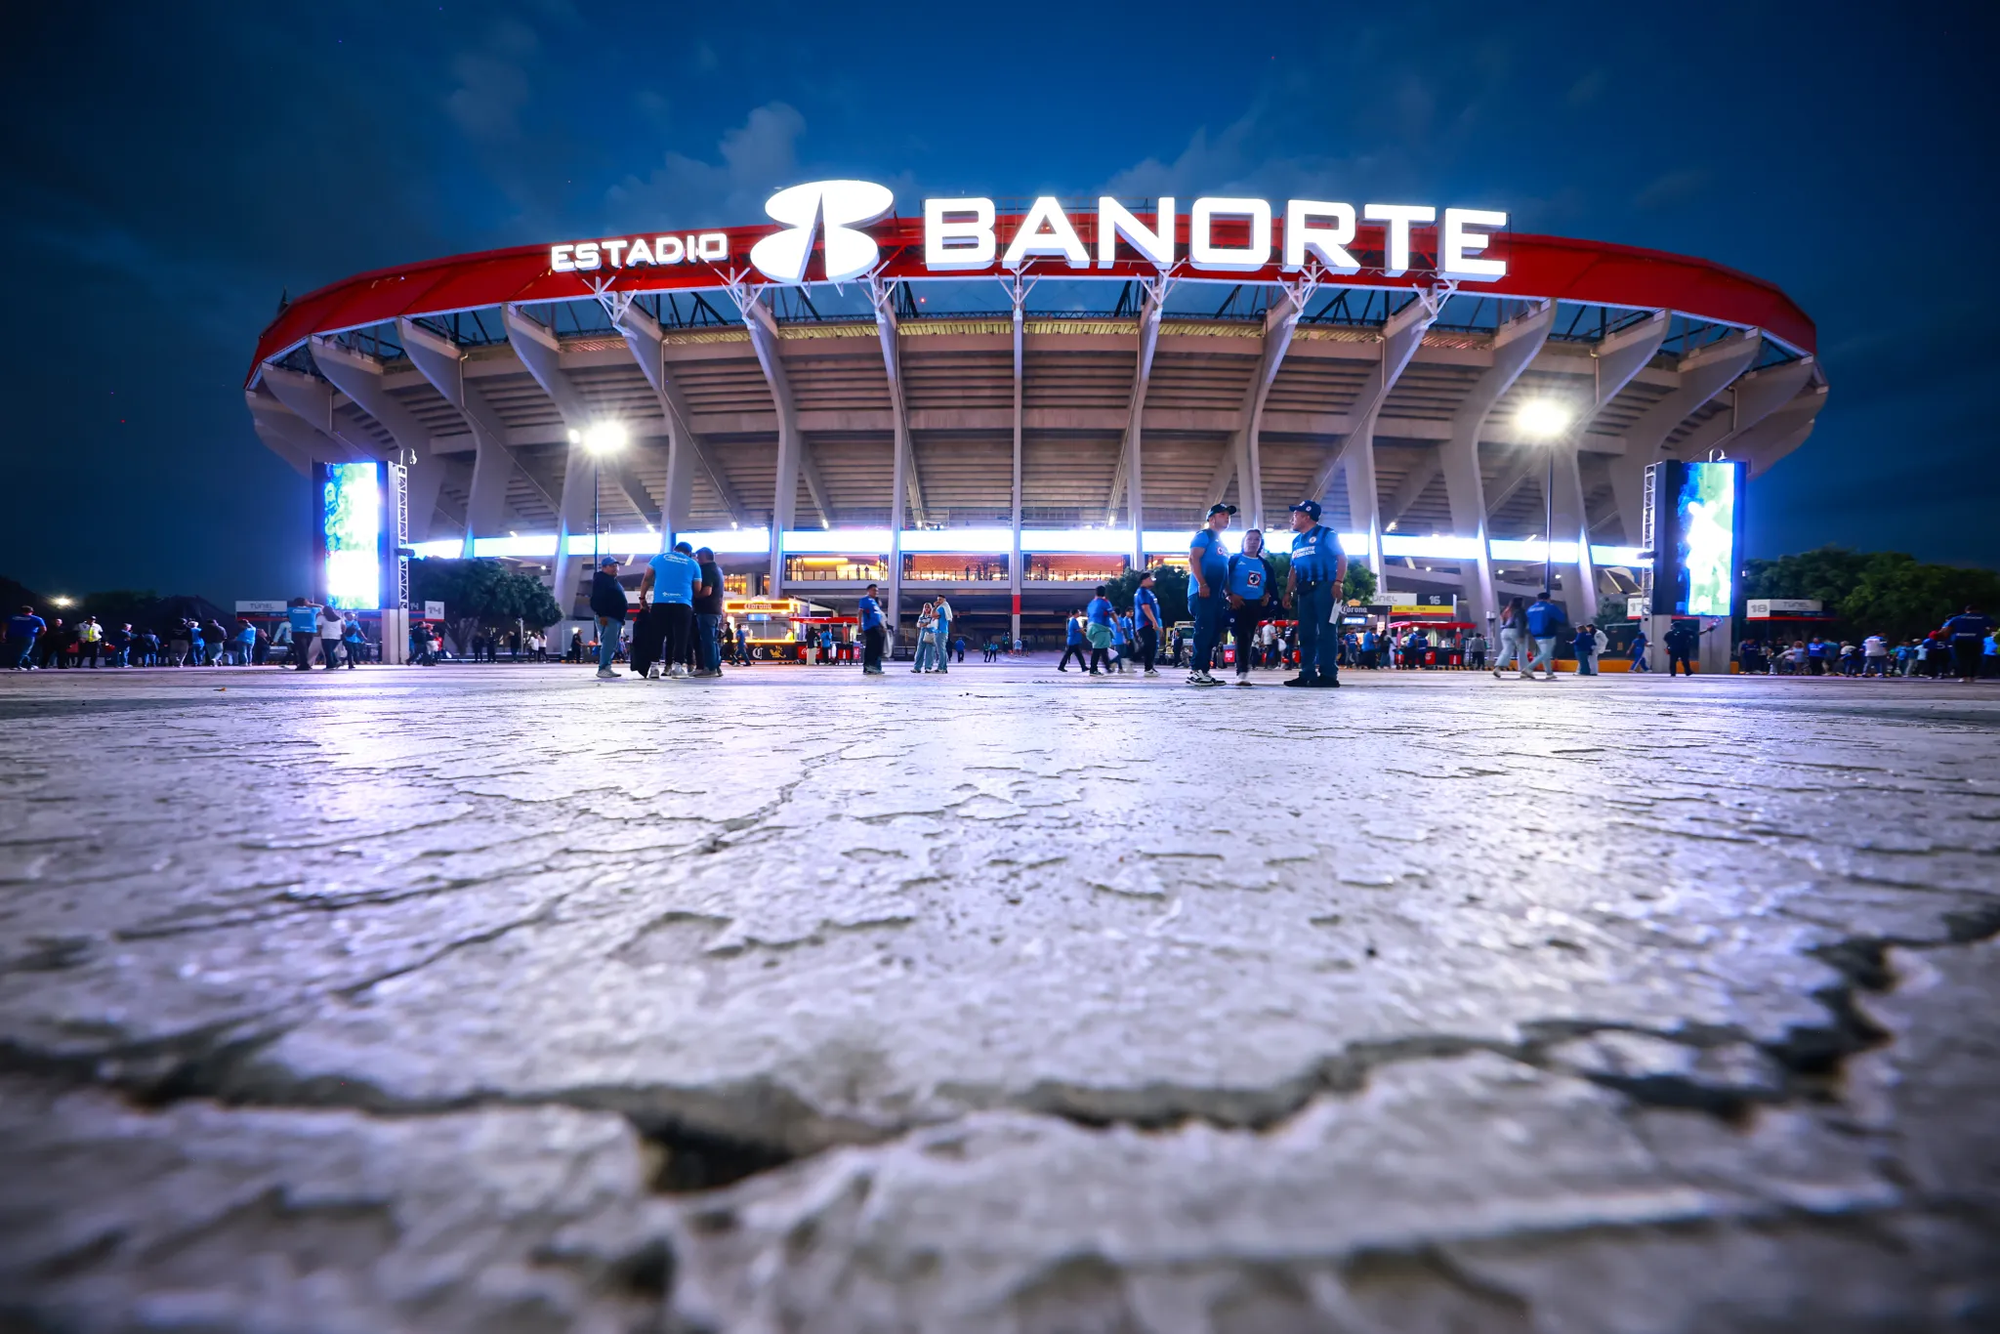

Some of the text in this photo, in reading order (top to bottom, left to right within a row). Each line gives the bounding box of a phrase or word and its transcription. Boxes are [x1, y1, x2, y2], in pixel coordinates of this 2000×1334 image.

[551, 196, 1508, 283] ESTADIO BANORTE
[1429, 596, 1441, 605] 16
[1340, 605, 1367, 614] Corona
[1751, 604, 1767, 613] 18
